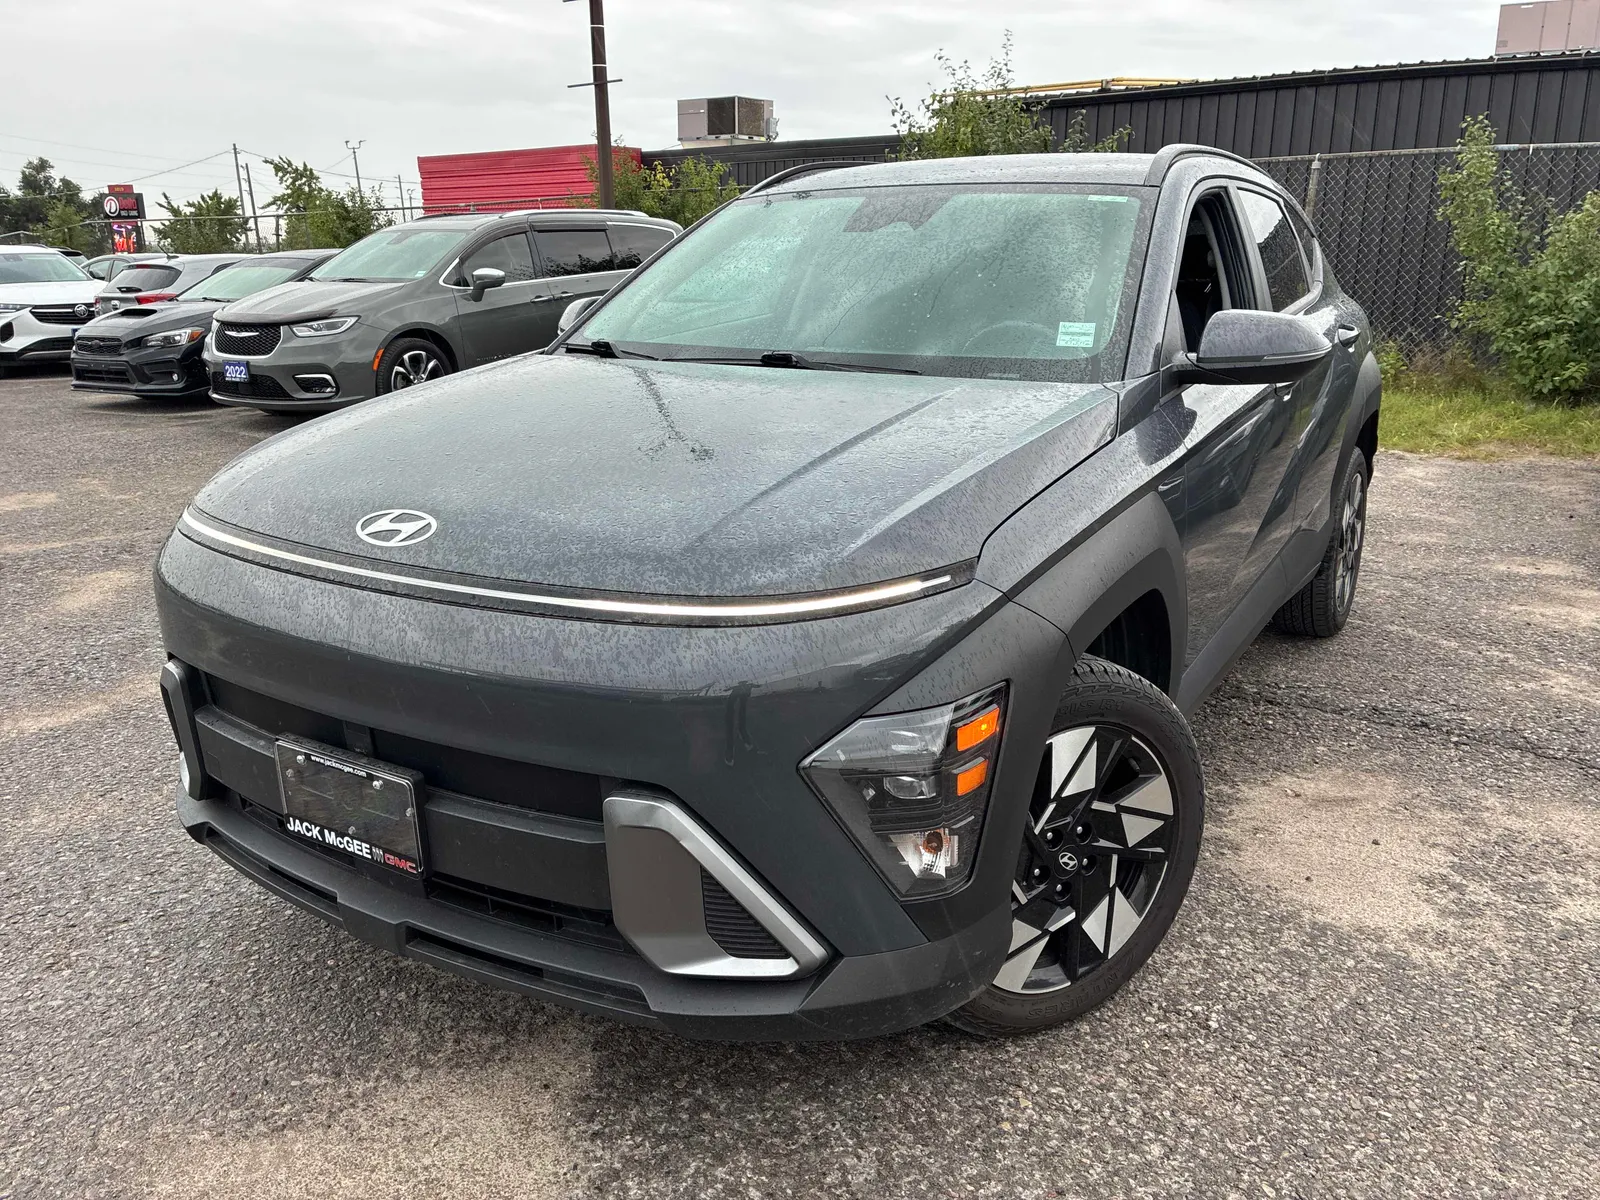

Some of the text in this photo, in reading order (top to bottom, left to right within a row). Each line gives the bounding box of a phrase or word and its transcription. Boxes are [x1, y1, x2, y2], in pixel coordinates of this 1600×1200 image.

[225, 365, 247, 378] 2022
[310, 755, 367, 778] www.jackmcgee.com
[286, 816, 417, 873] JACK McGEE GMC
